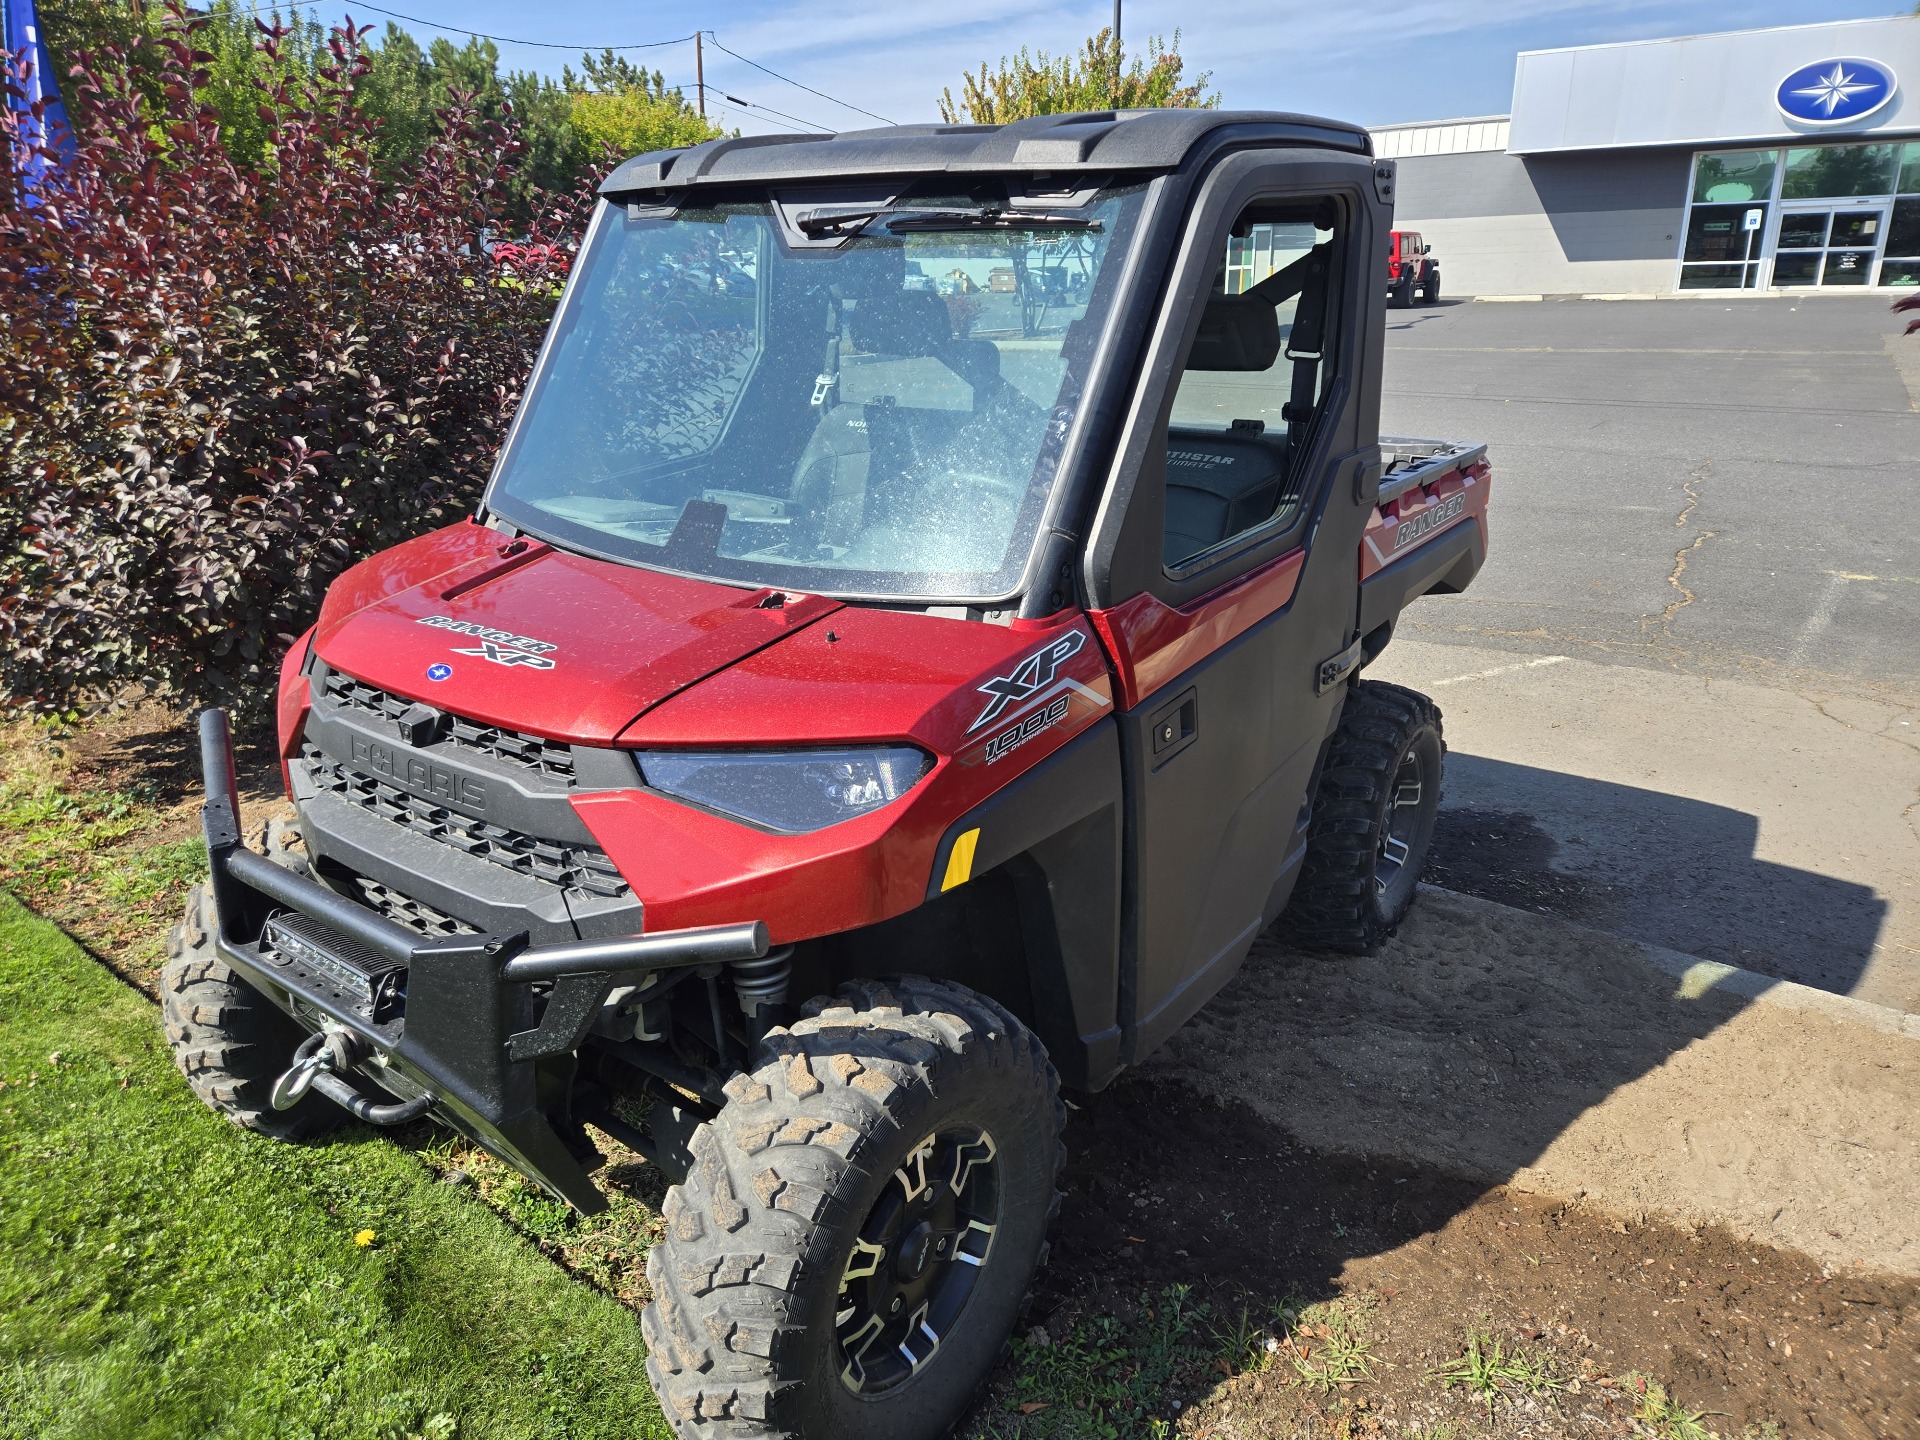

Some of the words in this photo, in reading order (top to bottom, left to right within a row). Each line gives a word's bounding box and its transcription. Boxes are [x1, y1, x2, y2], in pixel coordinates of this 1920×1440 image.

[1394, 492, 1465, 549] RANGER
[415, 615, 557, 654] RANGER
[450, 641, 556, 669] XP
[966, 629, 1087, 735] XP
[985, 693, 1070, 761] 1000
[351, 734, 486, 812] POLARIS
